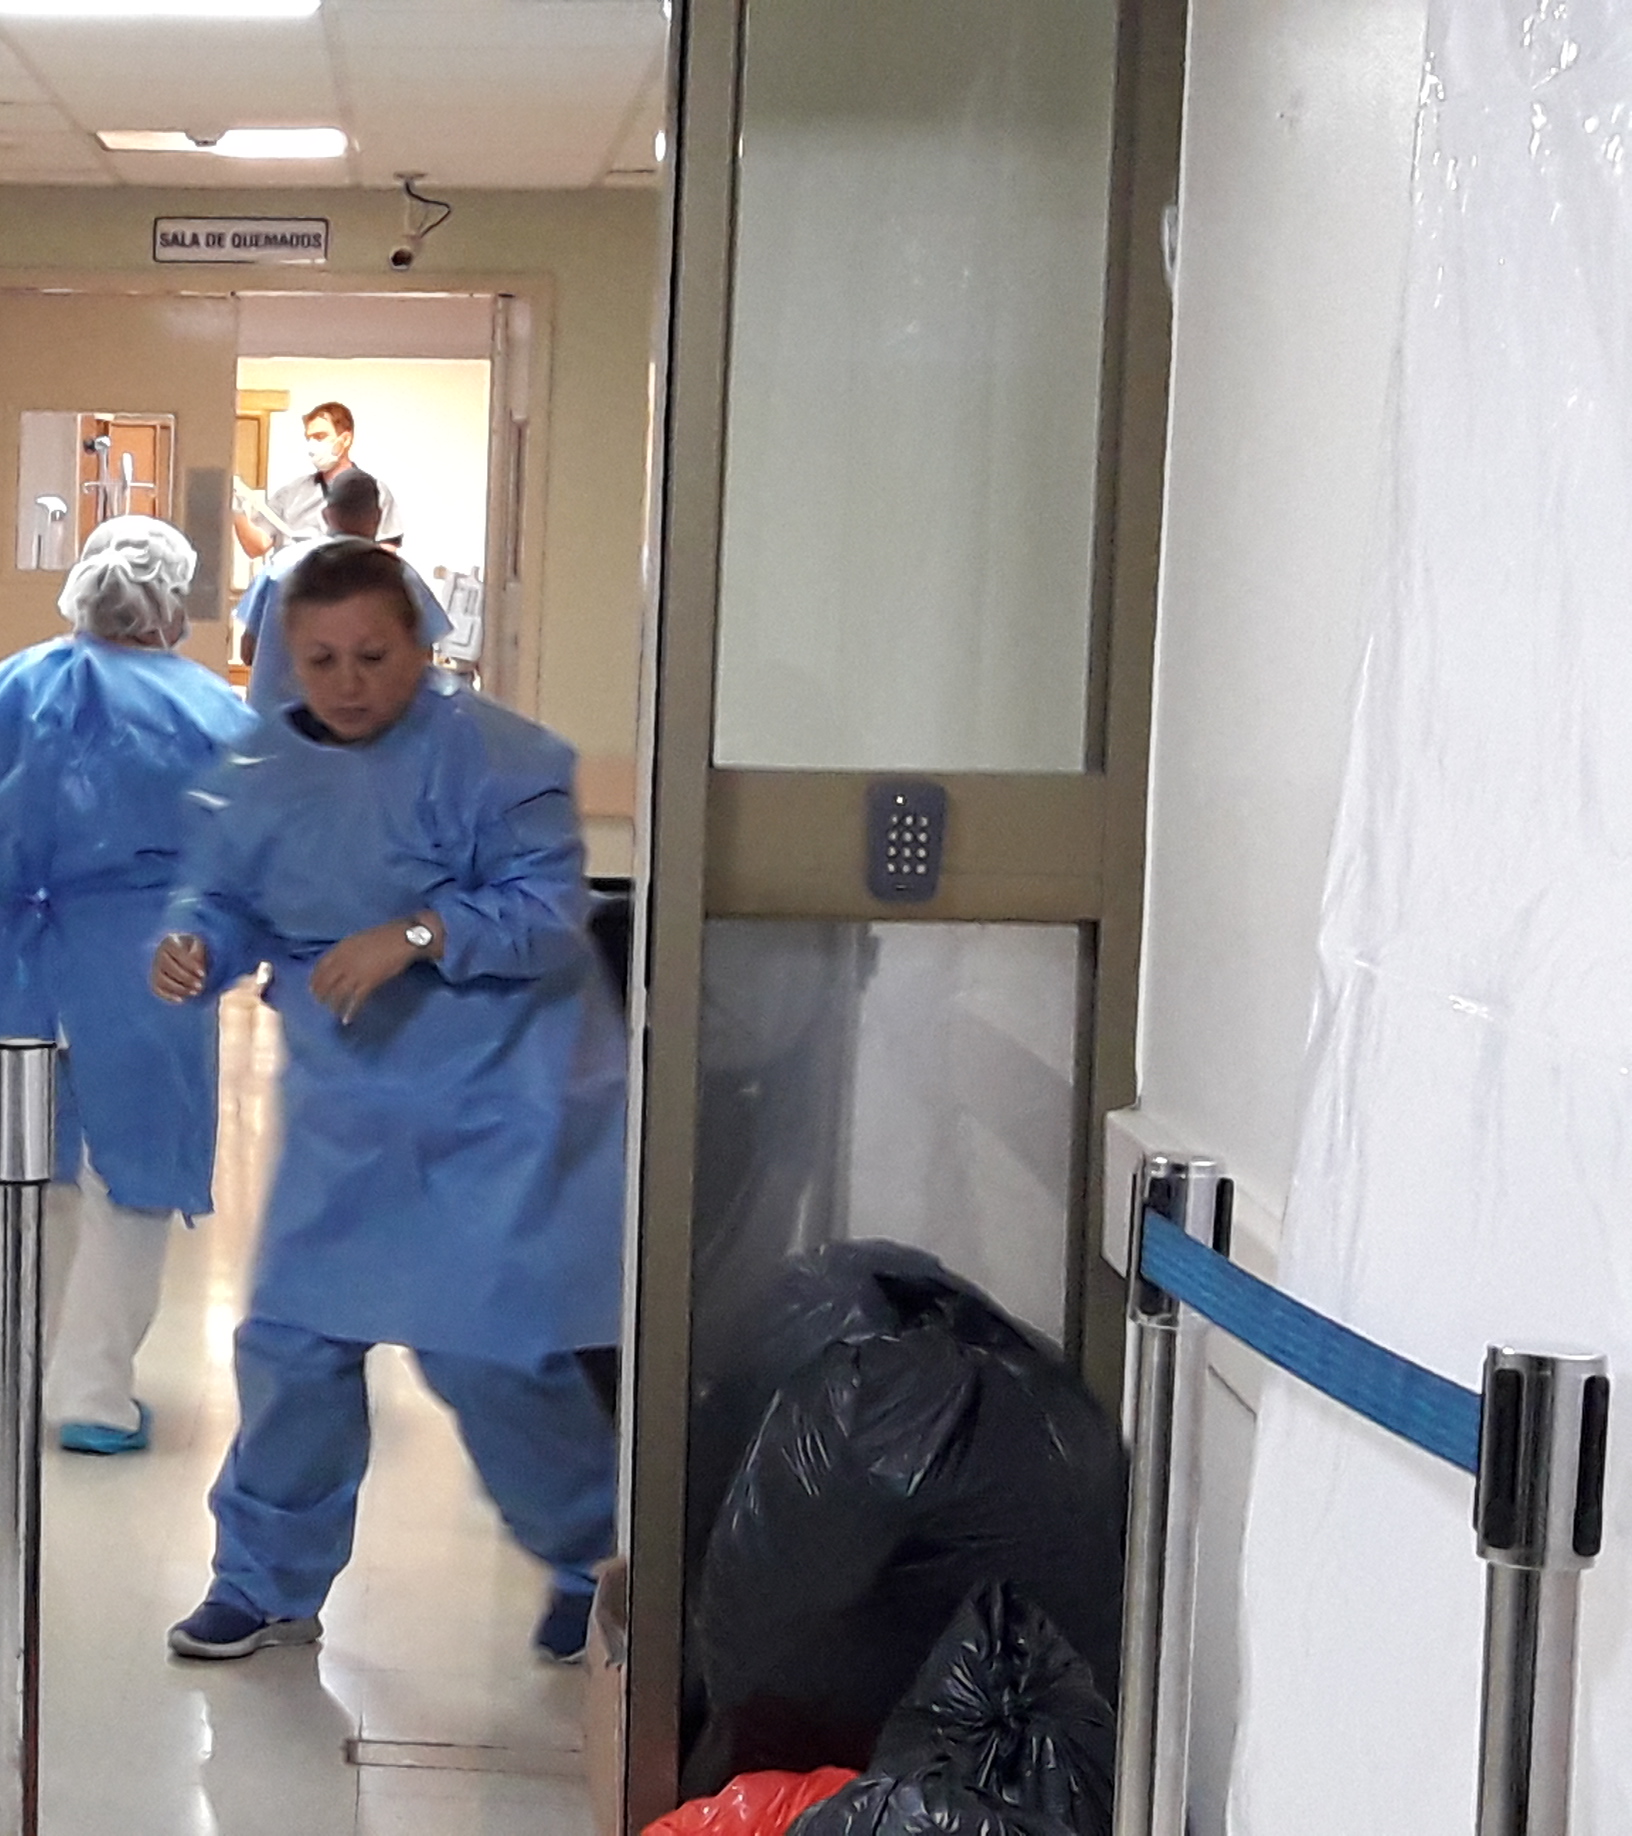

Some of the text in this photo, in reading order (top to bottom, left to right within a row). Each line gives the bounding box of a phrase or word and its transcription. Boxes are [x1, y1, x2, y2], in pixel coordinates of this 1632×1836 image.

[159, 232, 322, 249] SALA DE QUEMADOS
